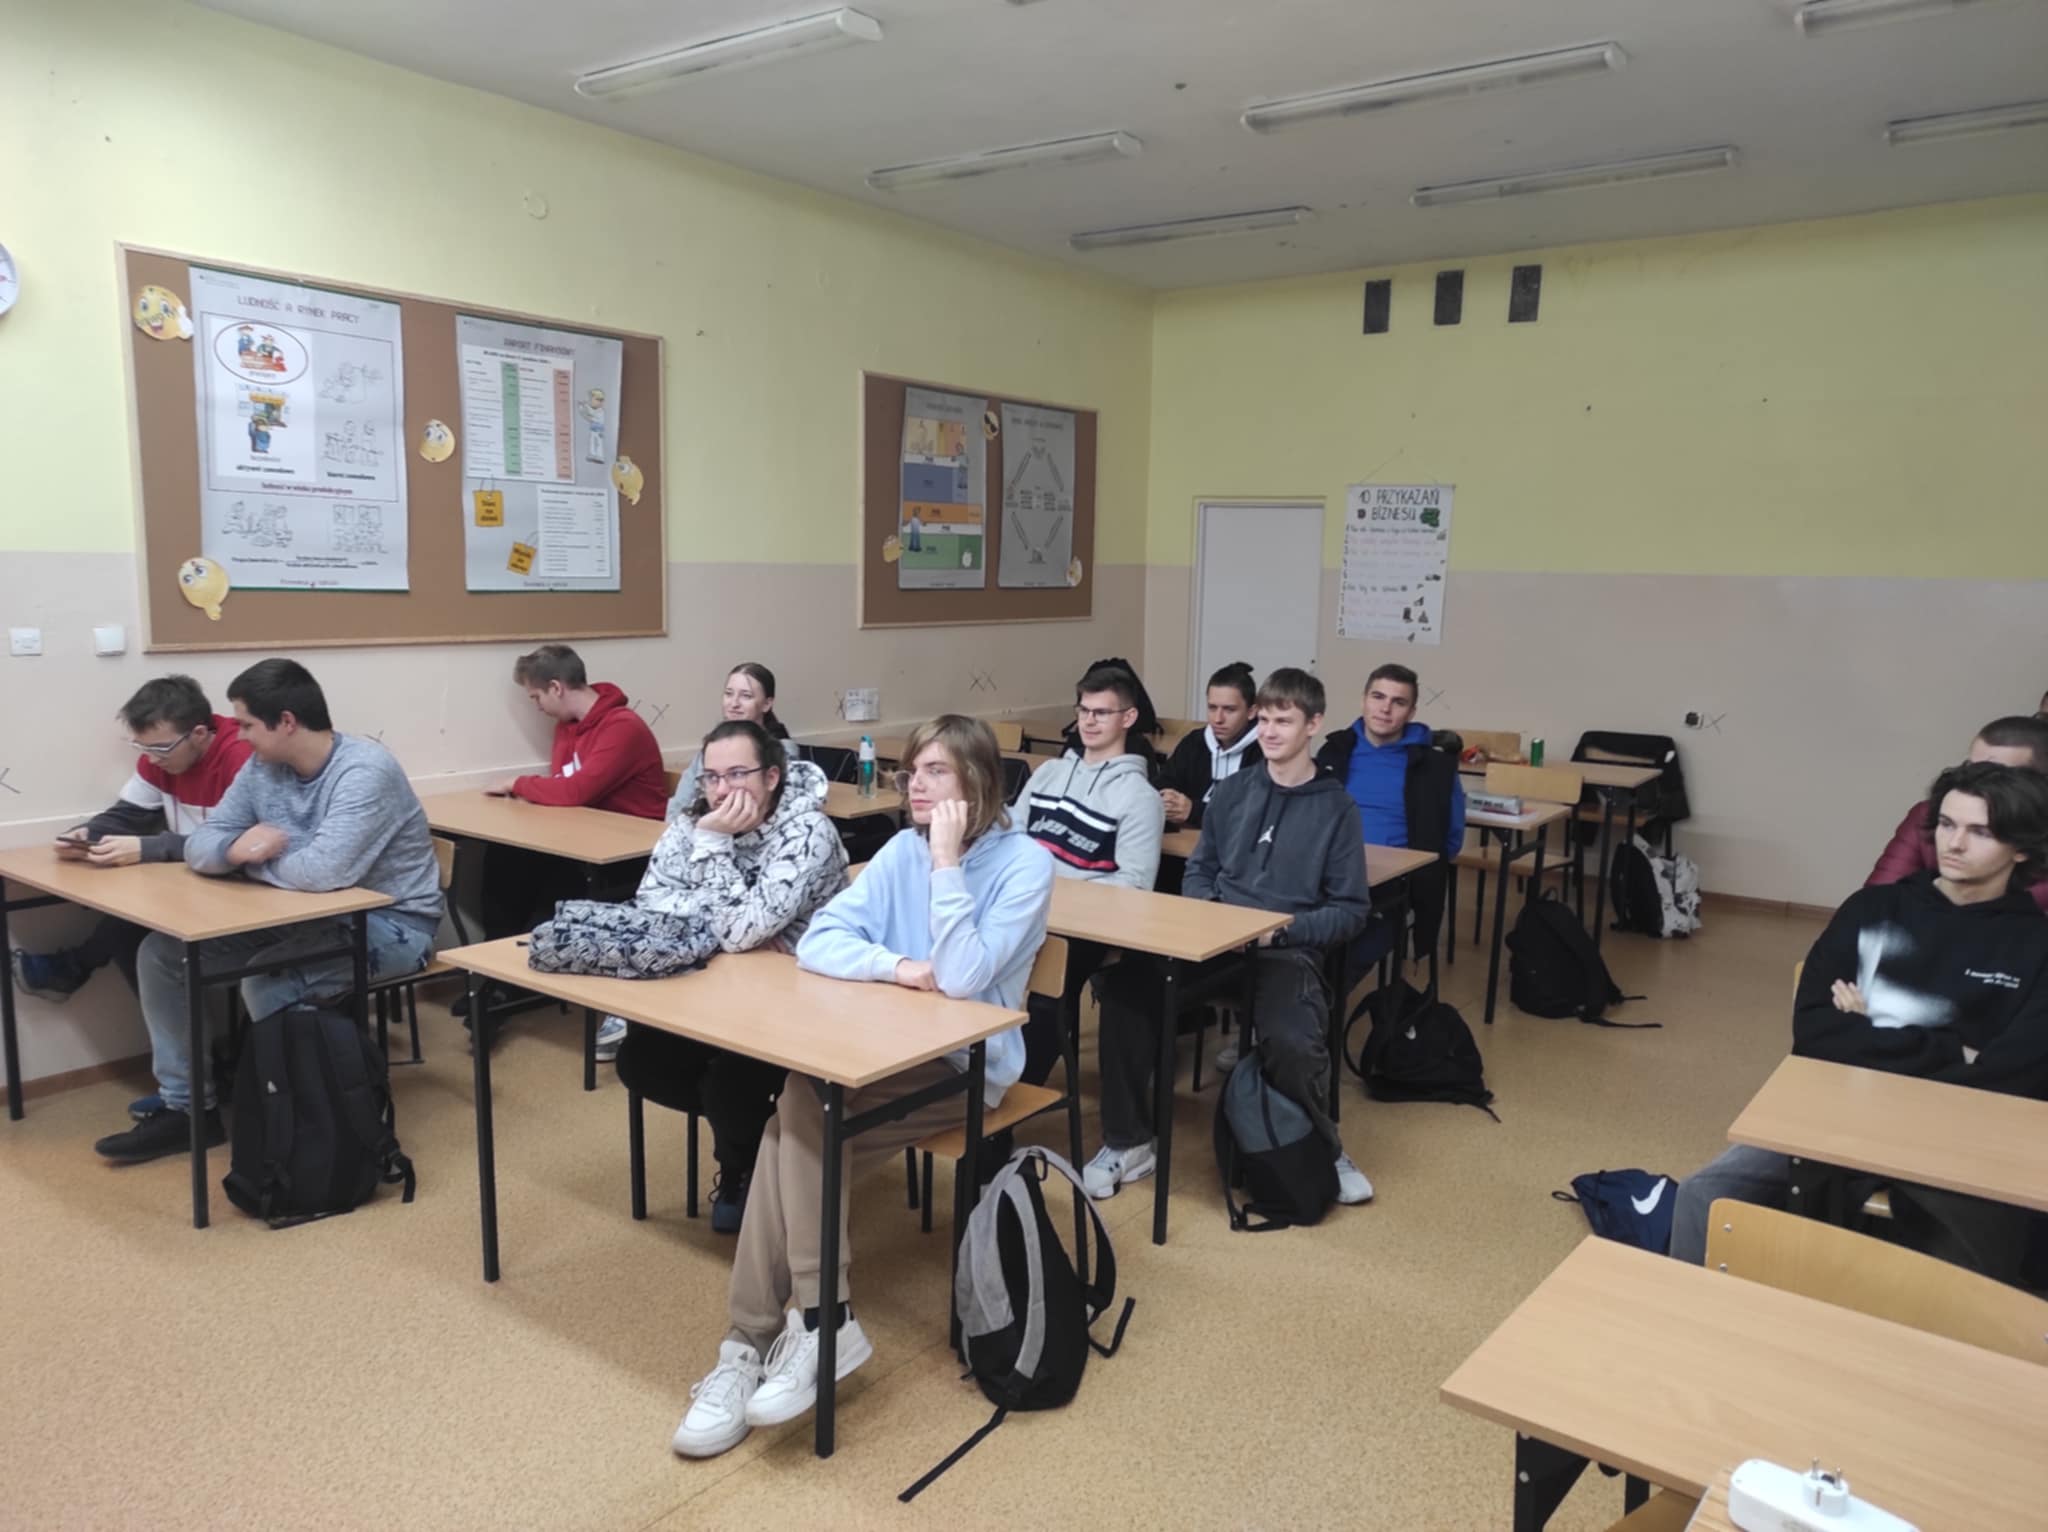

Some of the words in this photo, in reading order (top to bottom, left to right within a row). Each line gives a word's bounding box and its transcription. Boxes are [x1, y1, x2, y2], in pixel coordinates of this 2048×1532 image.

[286, 303, 293, 313] A
[297, 304, 325, 319] RYNEK
[330, 309, 361, 324] PRACY
[1359, 489, 1371, 504] 10
[1376, 487, 1440, 505] PRZYKAZAŃ
